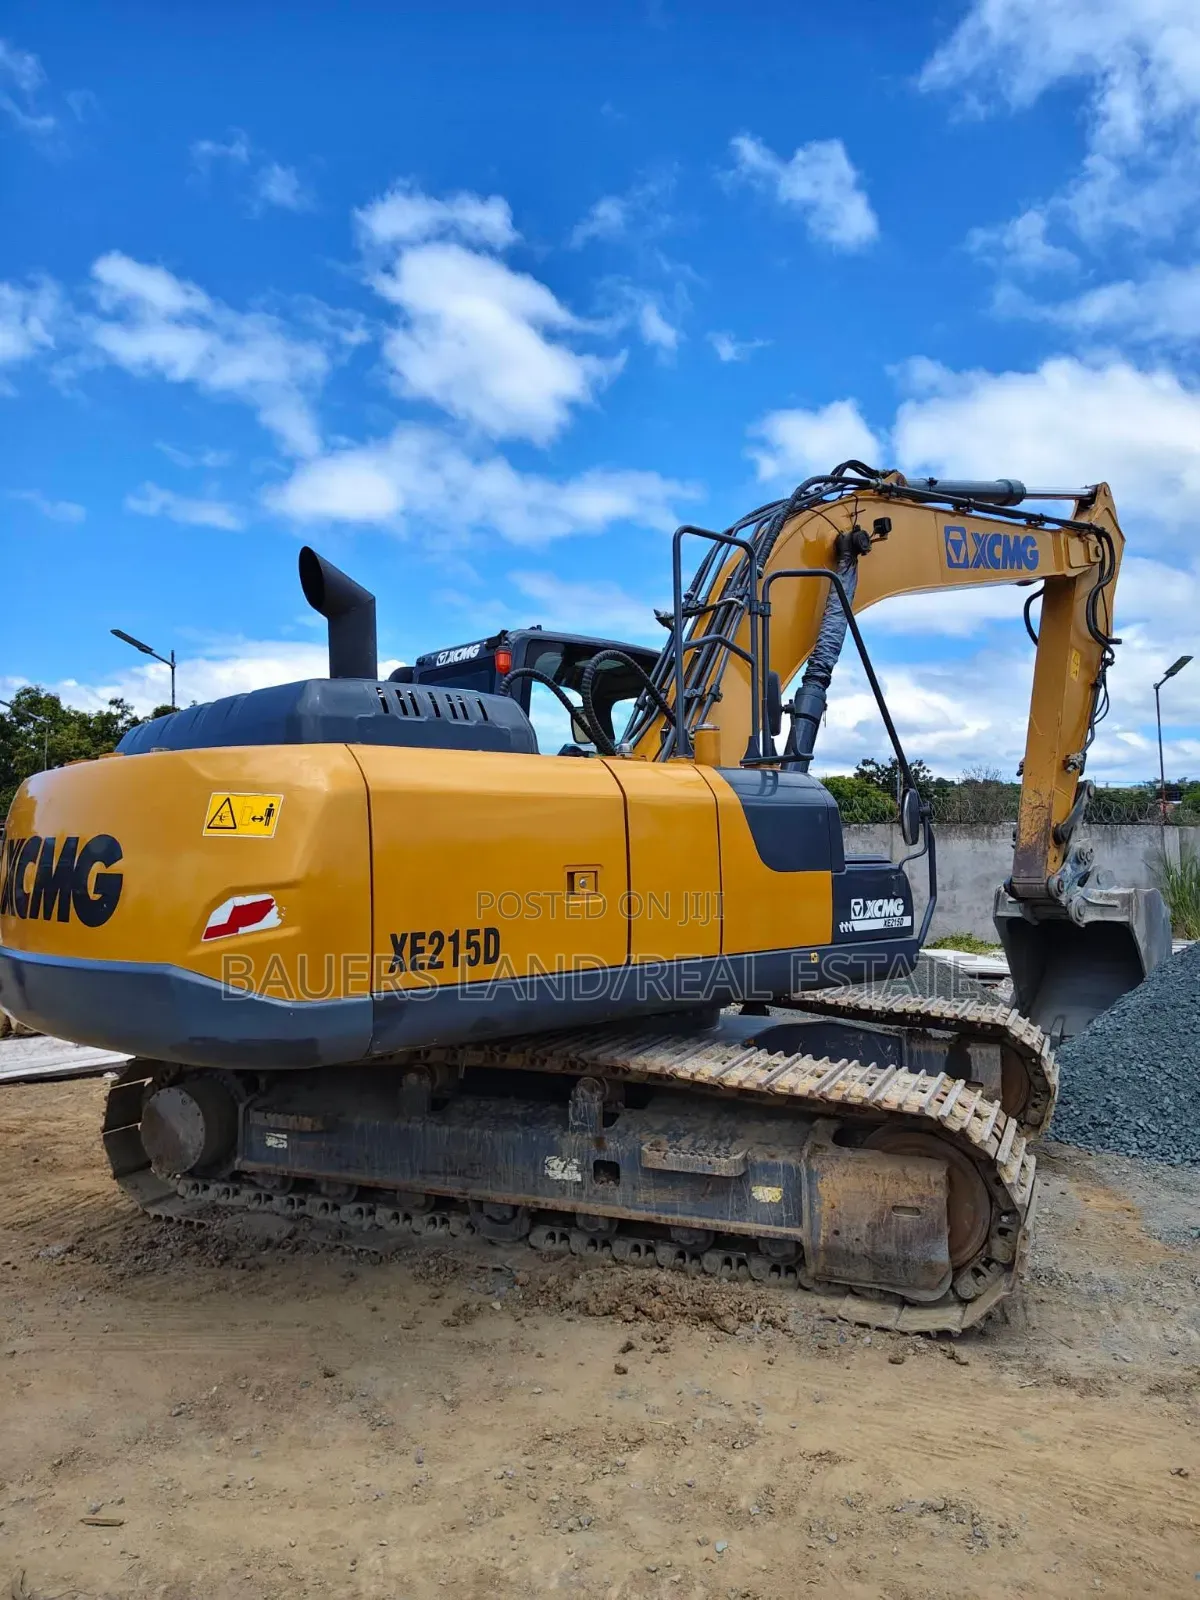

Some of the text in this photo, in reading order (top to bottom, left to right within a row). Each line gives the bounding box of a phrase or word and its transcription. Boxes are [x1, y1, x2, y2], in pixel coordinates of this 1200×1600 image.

[970, 532, 1039, 571] XCMG
[446, 644, 480, 663] XCMG
[0, 834, 124, 928] XCMG
[863, 898, 904, 918] XCMG
[388, 927, 500, 974] XE215D
